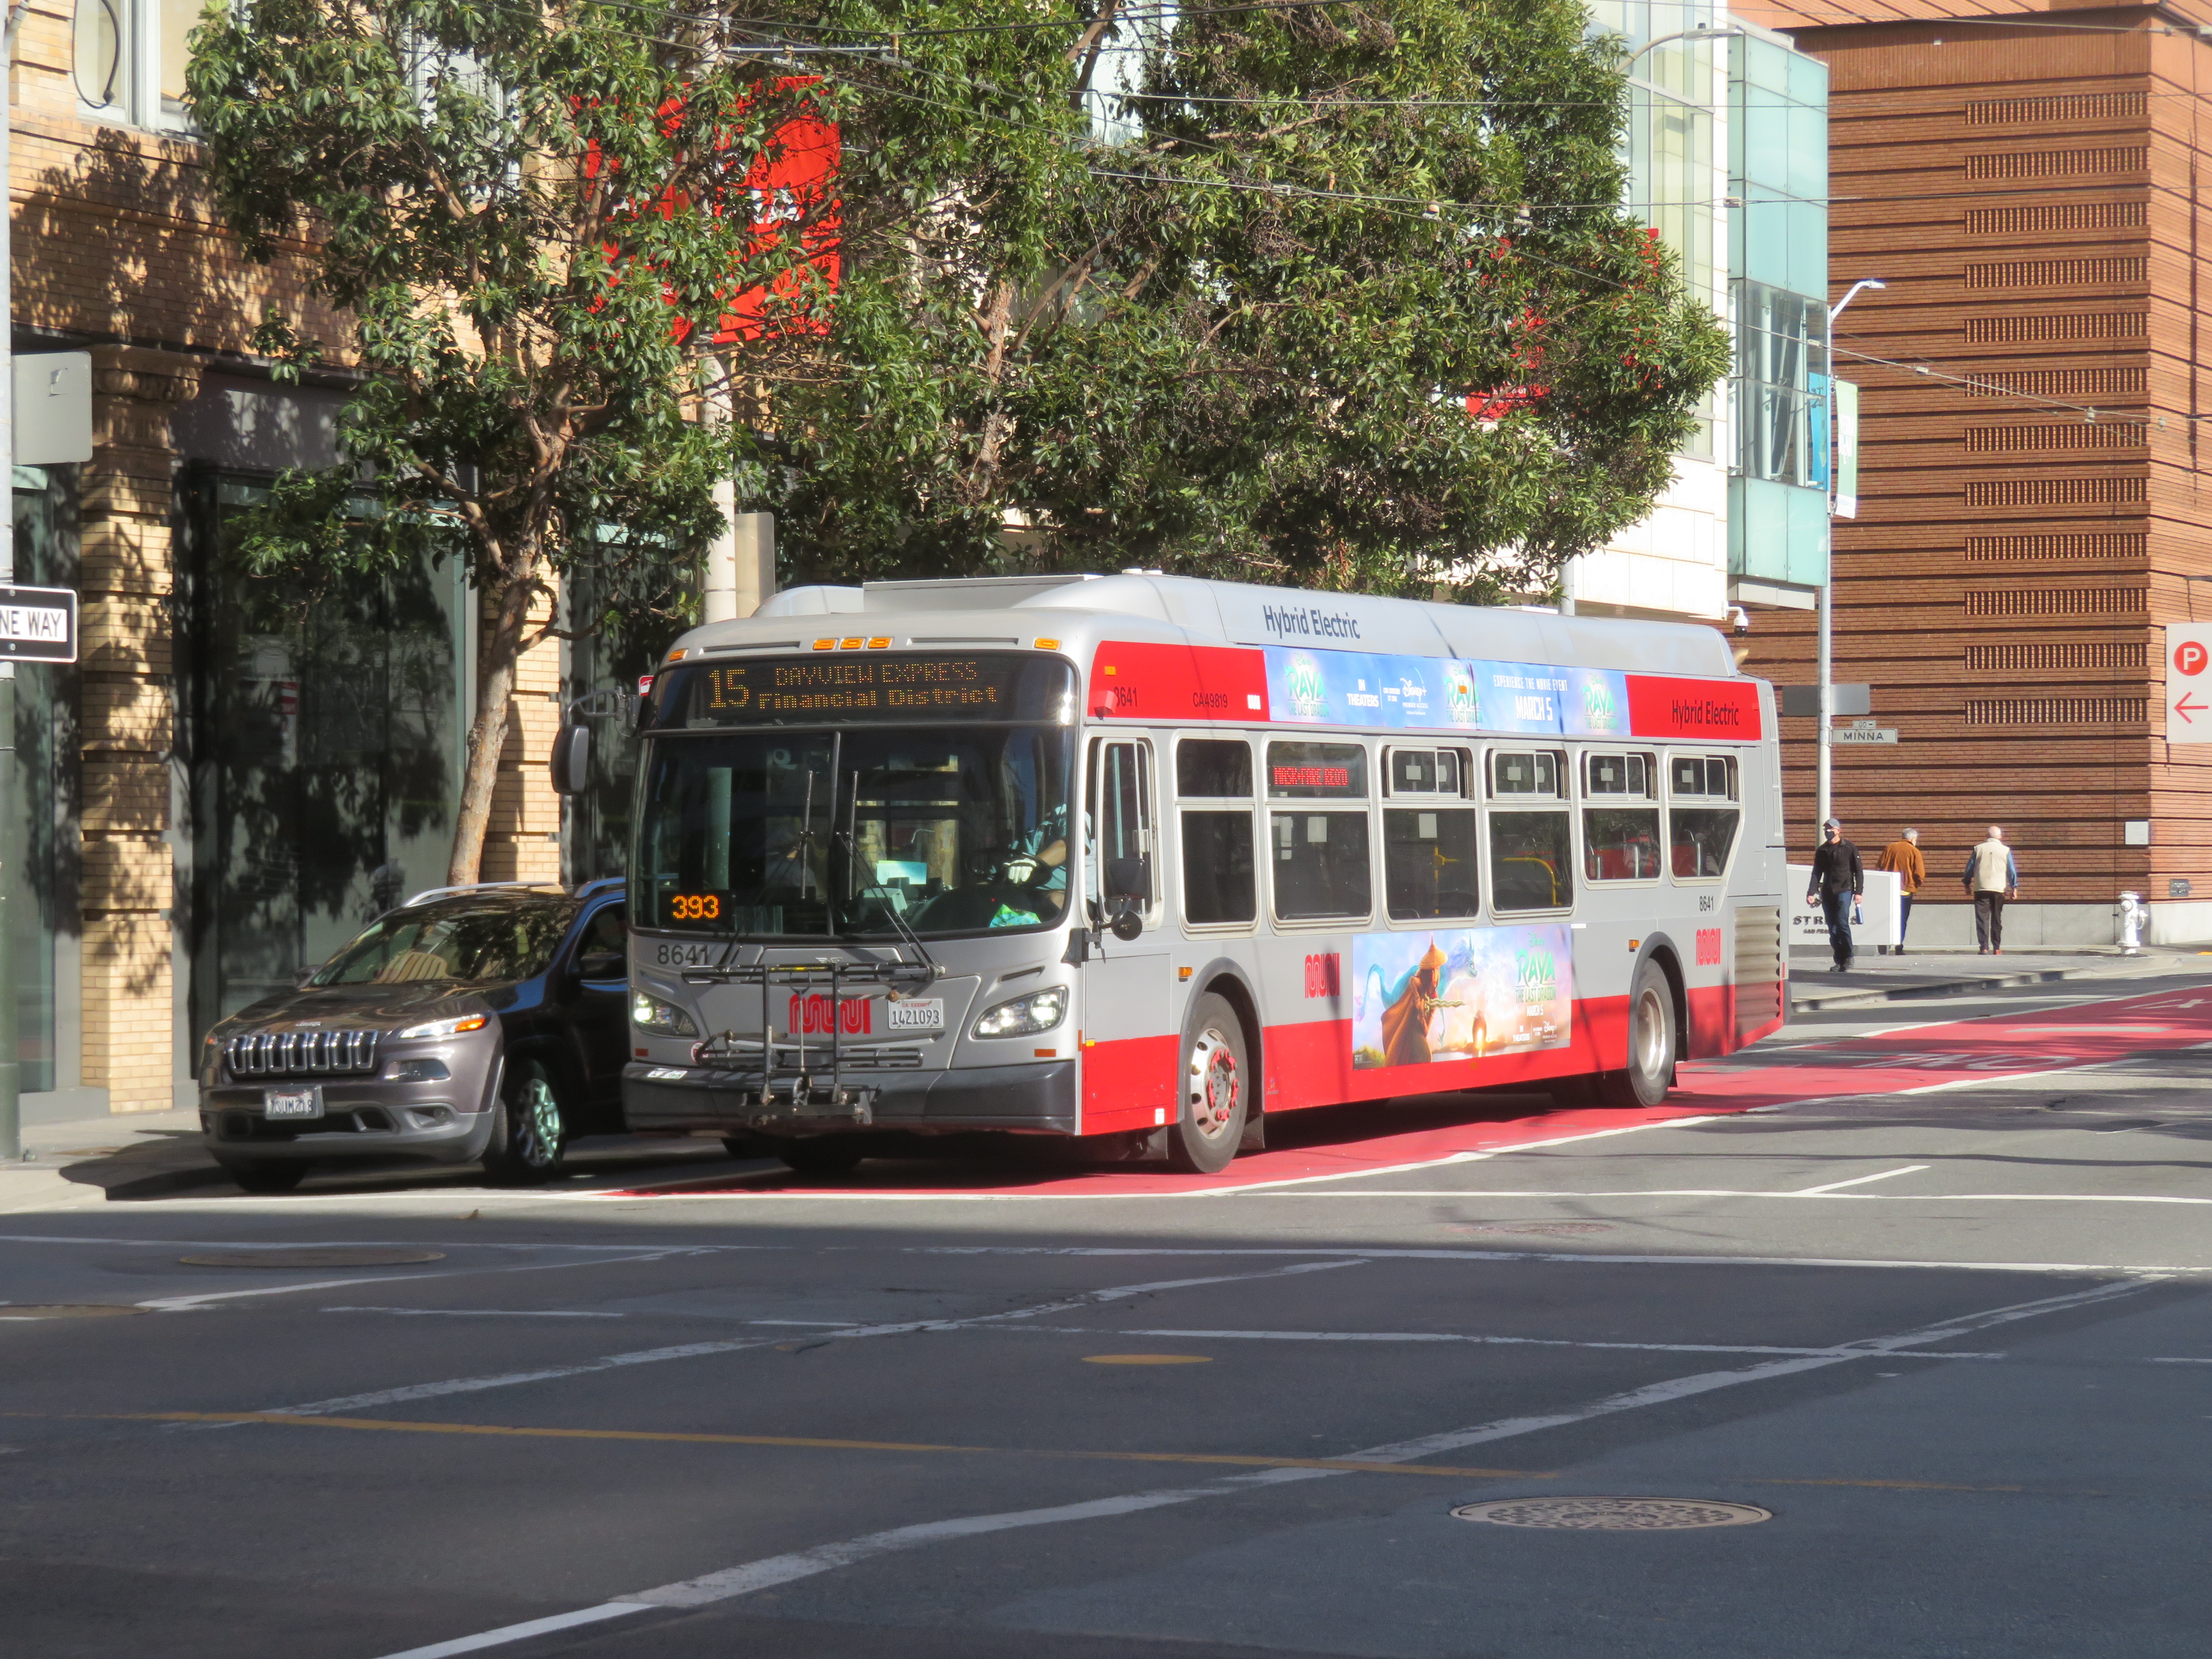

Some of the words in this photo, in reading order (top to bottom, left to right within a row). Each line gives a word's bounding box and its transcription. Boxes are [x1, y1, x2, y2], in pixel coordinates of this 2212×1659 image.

[0, 609, 20, 635] NE
[27, 611, 62, 637] WAY
[1262, 605, 1310, 639] Hybrid
[1310, 609, 1361, 639] Electric
[2183, 648, 2201, 670] P
[882, 662, 977, 683] EXPRESS
[1283, 663, 1327, 702] RAYA
[1493, 675, 1525, 689] EXPERIENCE
[1525, 678, 1535, 690] THE
[1536, 678, 1551, 691] MOVIE
[1552, 679, 1568, 691] EVENT
[709, 669, 749, 708] 15
[1358, 679, 1365, 691] IN
[1443, 676, 1481, 710] RAYA
[760, 690, 876, 709] Financial
[888, 686, 997, 705] District
[1114, 686, 1138, 707] 8641
[1193, 692, 1228, 708] CA49819
[1347, 693, 1379, 707] THEATERS
[1582, 685, 1616, 717] RAYA
[1287, 702, 1297, 716] THE
[1298, 703, 1310, 716] LAST
[1446, 710, 1454, 722] THE
[1455, 710, 1466, 723] LAST
[1515, 696, 1545, 721] MARCH
[1545, 697, 1553, 721] 5
[1672, 699, 1703, 729] Hybrid
[1706, 701, 1739, 725] Electric
[1843, 732, 1884, 741] MINNA
[672, 895, 719, 918] 393
[1699, 896, 1714, 911] 8641
[658, 944, 708, 965] 8641
[1516, 948, 1556, 987] RAYA
[1516, 989, 1524, 1003] THE
[1525, 988, 1537, 1002] LAST
[892, 1010, 940, 1025] 1421093
[1527, 1005, 1540, 1016] MARCH
[1540, 1004, 1543, 1016] 5
[1513, 1033, 1530, 1042] THEATERS
